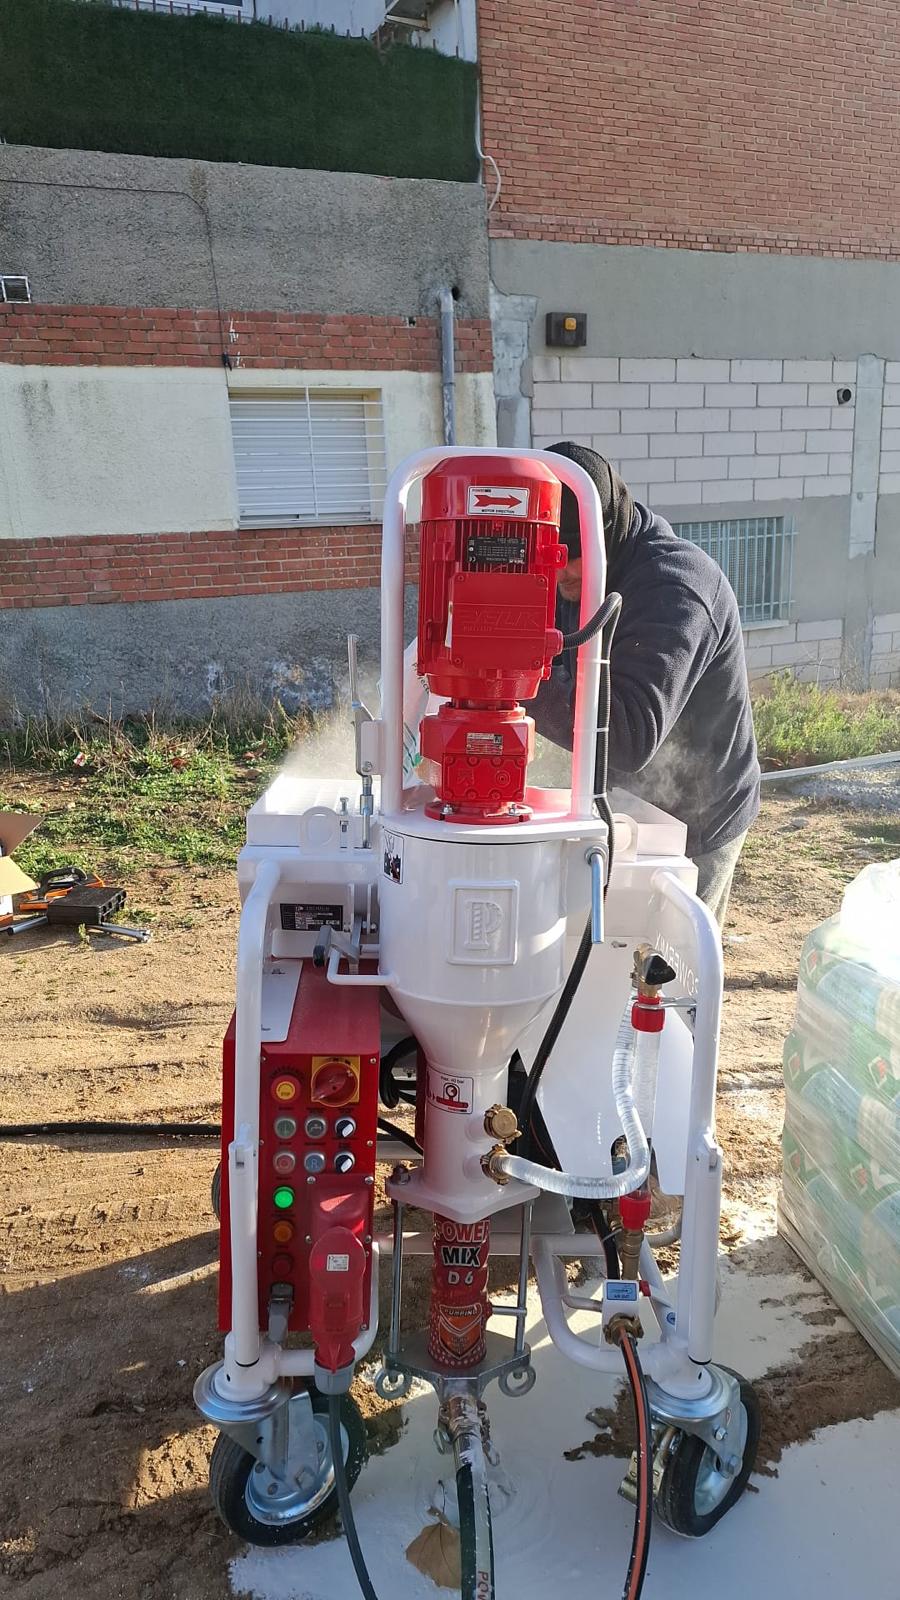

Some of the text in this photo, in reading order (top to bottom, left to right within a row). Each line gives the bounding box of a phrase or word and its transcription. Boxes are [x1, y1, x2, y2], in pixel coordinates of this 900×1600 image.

[441, 1246, 481, 1267] MIX
[448, 1271, 474, 1285] D 6
